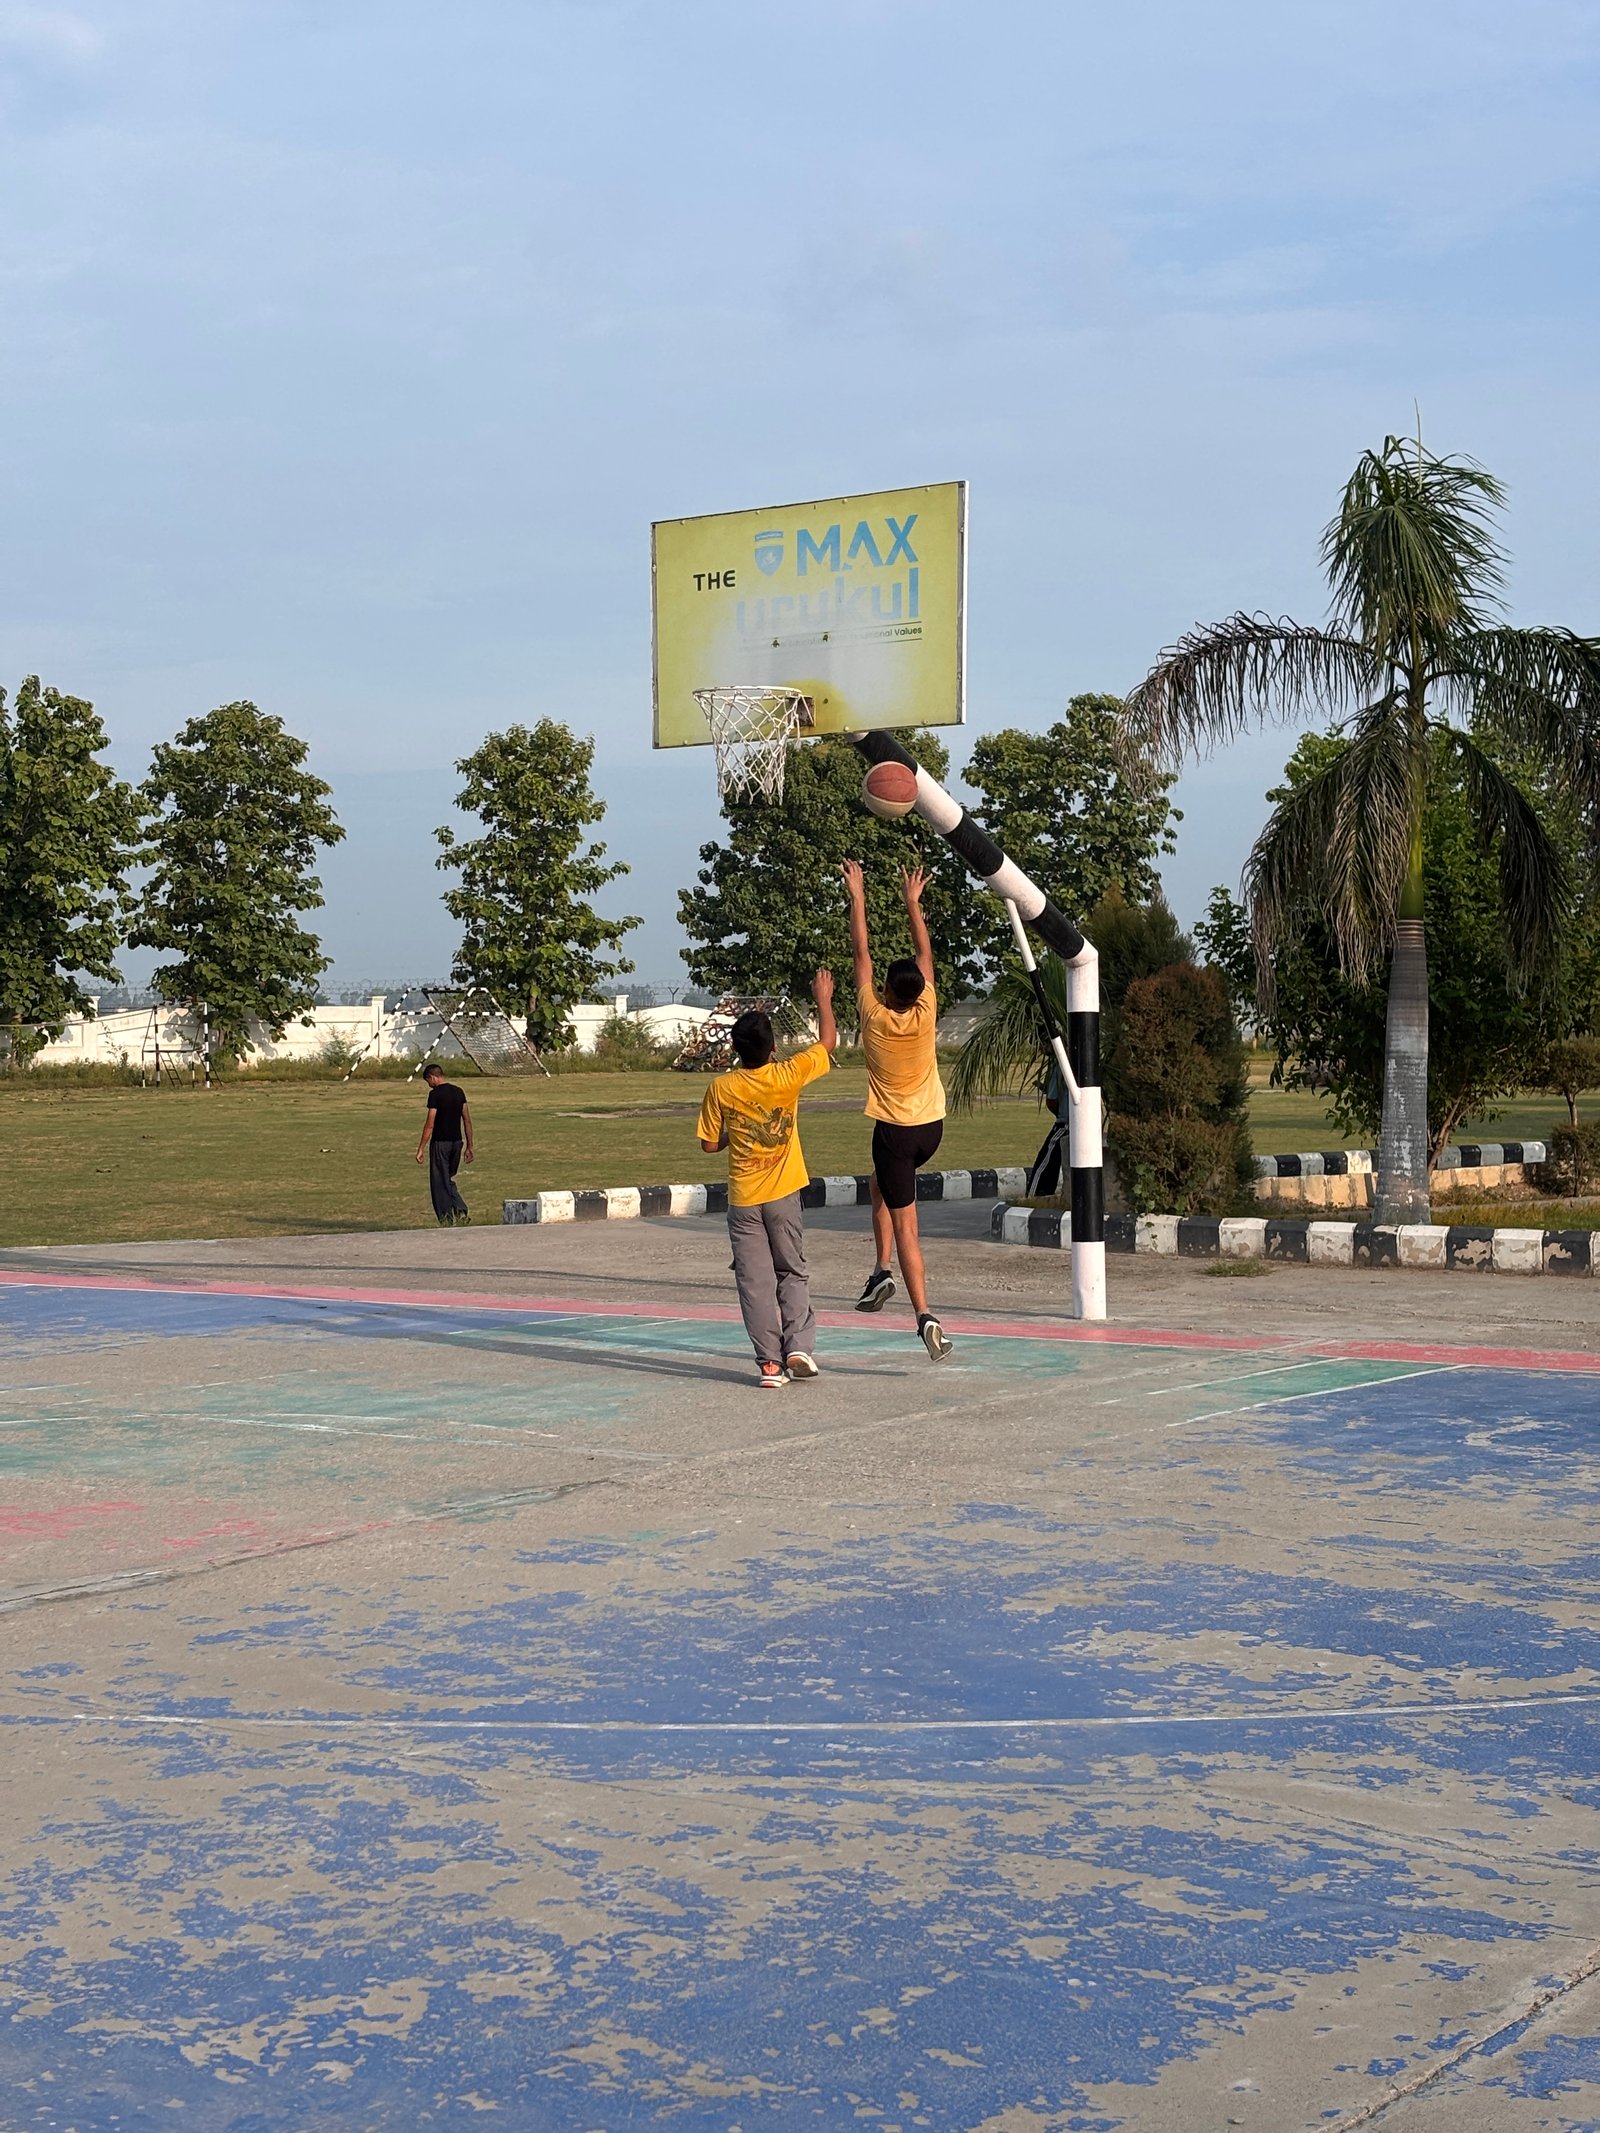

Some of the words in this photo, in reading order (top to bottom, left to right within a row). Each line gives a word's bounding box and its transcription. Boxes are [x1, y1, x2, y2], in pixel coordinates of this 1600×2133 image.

[693, 569, 736, 592] THE
[796, 514, 919, 577] MAX
[894, 626, 923, 637] Values
